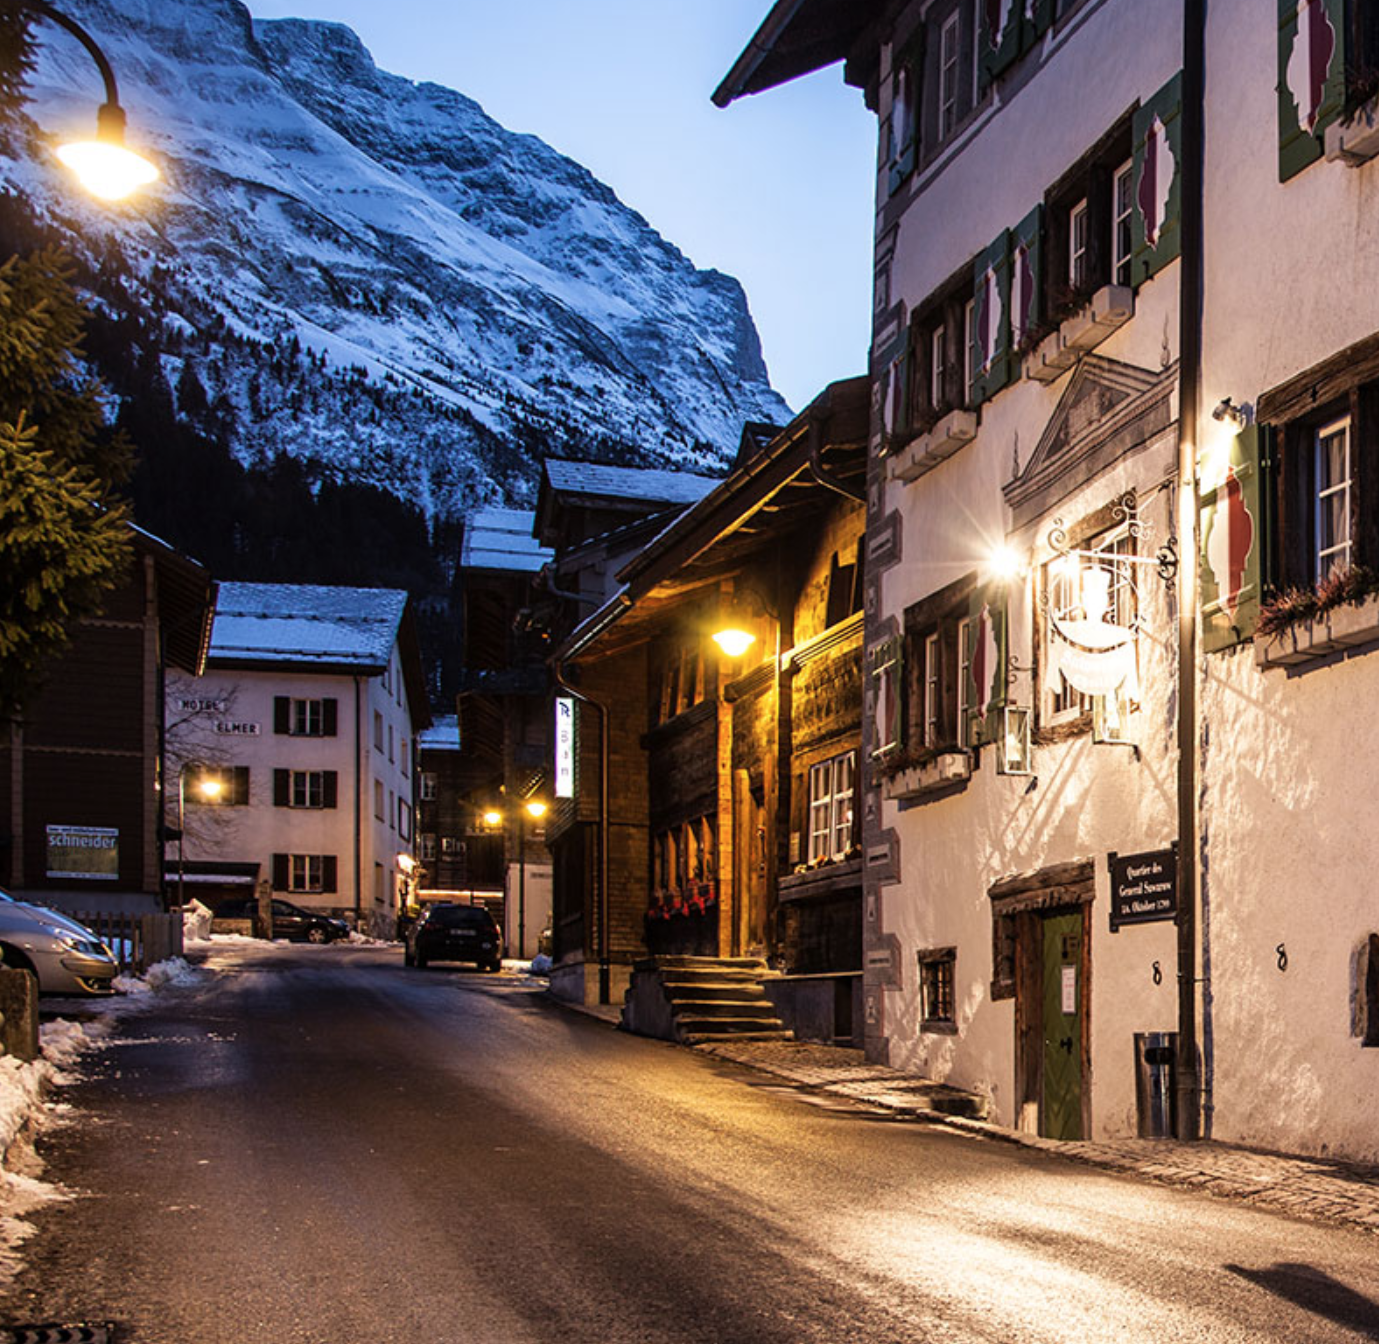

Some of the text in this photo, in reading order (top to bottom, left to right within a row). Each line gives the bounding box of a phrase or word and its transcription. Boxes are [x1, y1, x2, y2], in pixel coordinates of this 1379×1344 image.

[182, 700, 219, 711] HOTEL
[217, 723, 257, 733] ELMER
[50, 833, 116, 849] schneider
[1119, 882, 1143, 897] General
